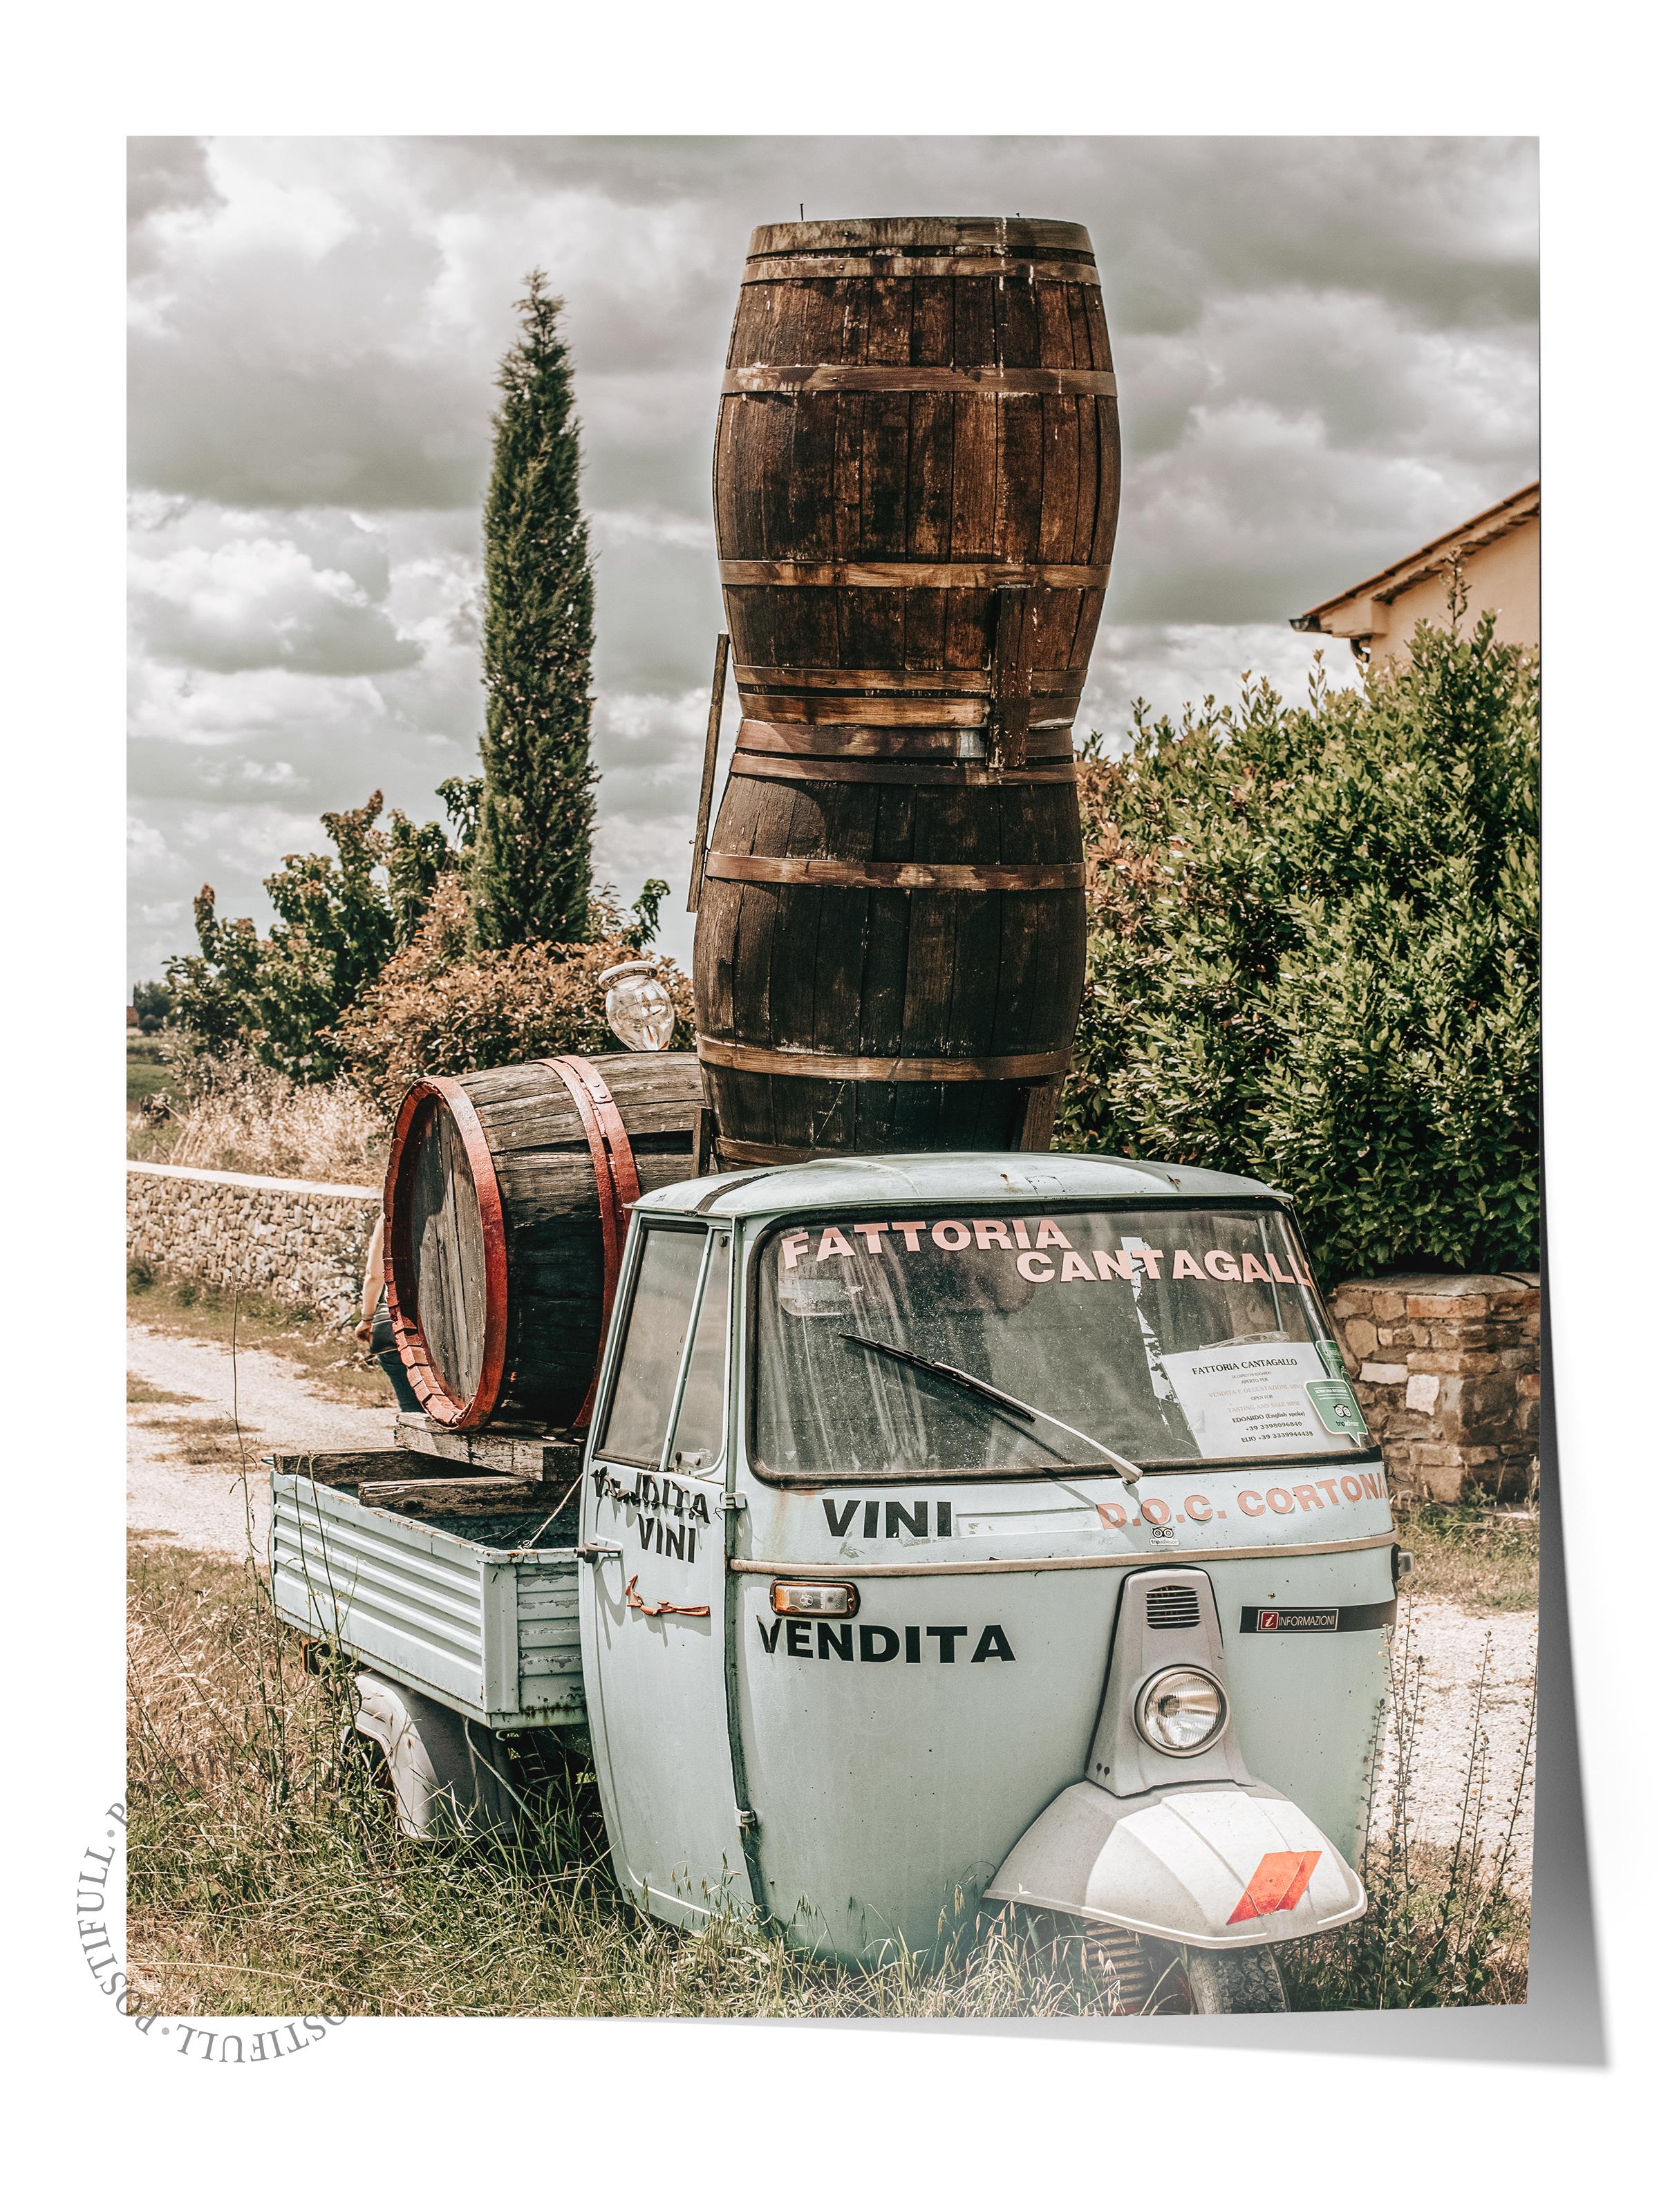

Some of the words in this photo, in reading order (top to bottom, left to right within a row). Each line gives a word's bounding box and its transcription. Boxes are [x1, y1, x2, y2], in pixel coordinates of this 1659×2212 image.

[781, 1219, 1072, 1270] FATTORIA
[1016, 1249, 1316, 1290] CANTAGALL
[1192, 1362, 1239, 1375] FATTORIA
[1241, 1358, 1297, 1369] CANTAGALLO
[1208, 1389, 1237, 1398] VENDITA
[1228, 1405, 1255, 1413] TASTING
[1232, 1414, 1264, 1423] EDOARDO
[1261, 1421, 1302, 1430] 3398096840
[822, 1499, 952, 1539] VINI
[1097, 1494, 1227, 1530] D.O.C.
[637, 1512, 697, 1564] VINI
[1278, 1615, 1335, 1627] INFORMAZIONI
[756, 1615, 1017, 1664] VENDITA
